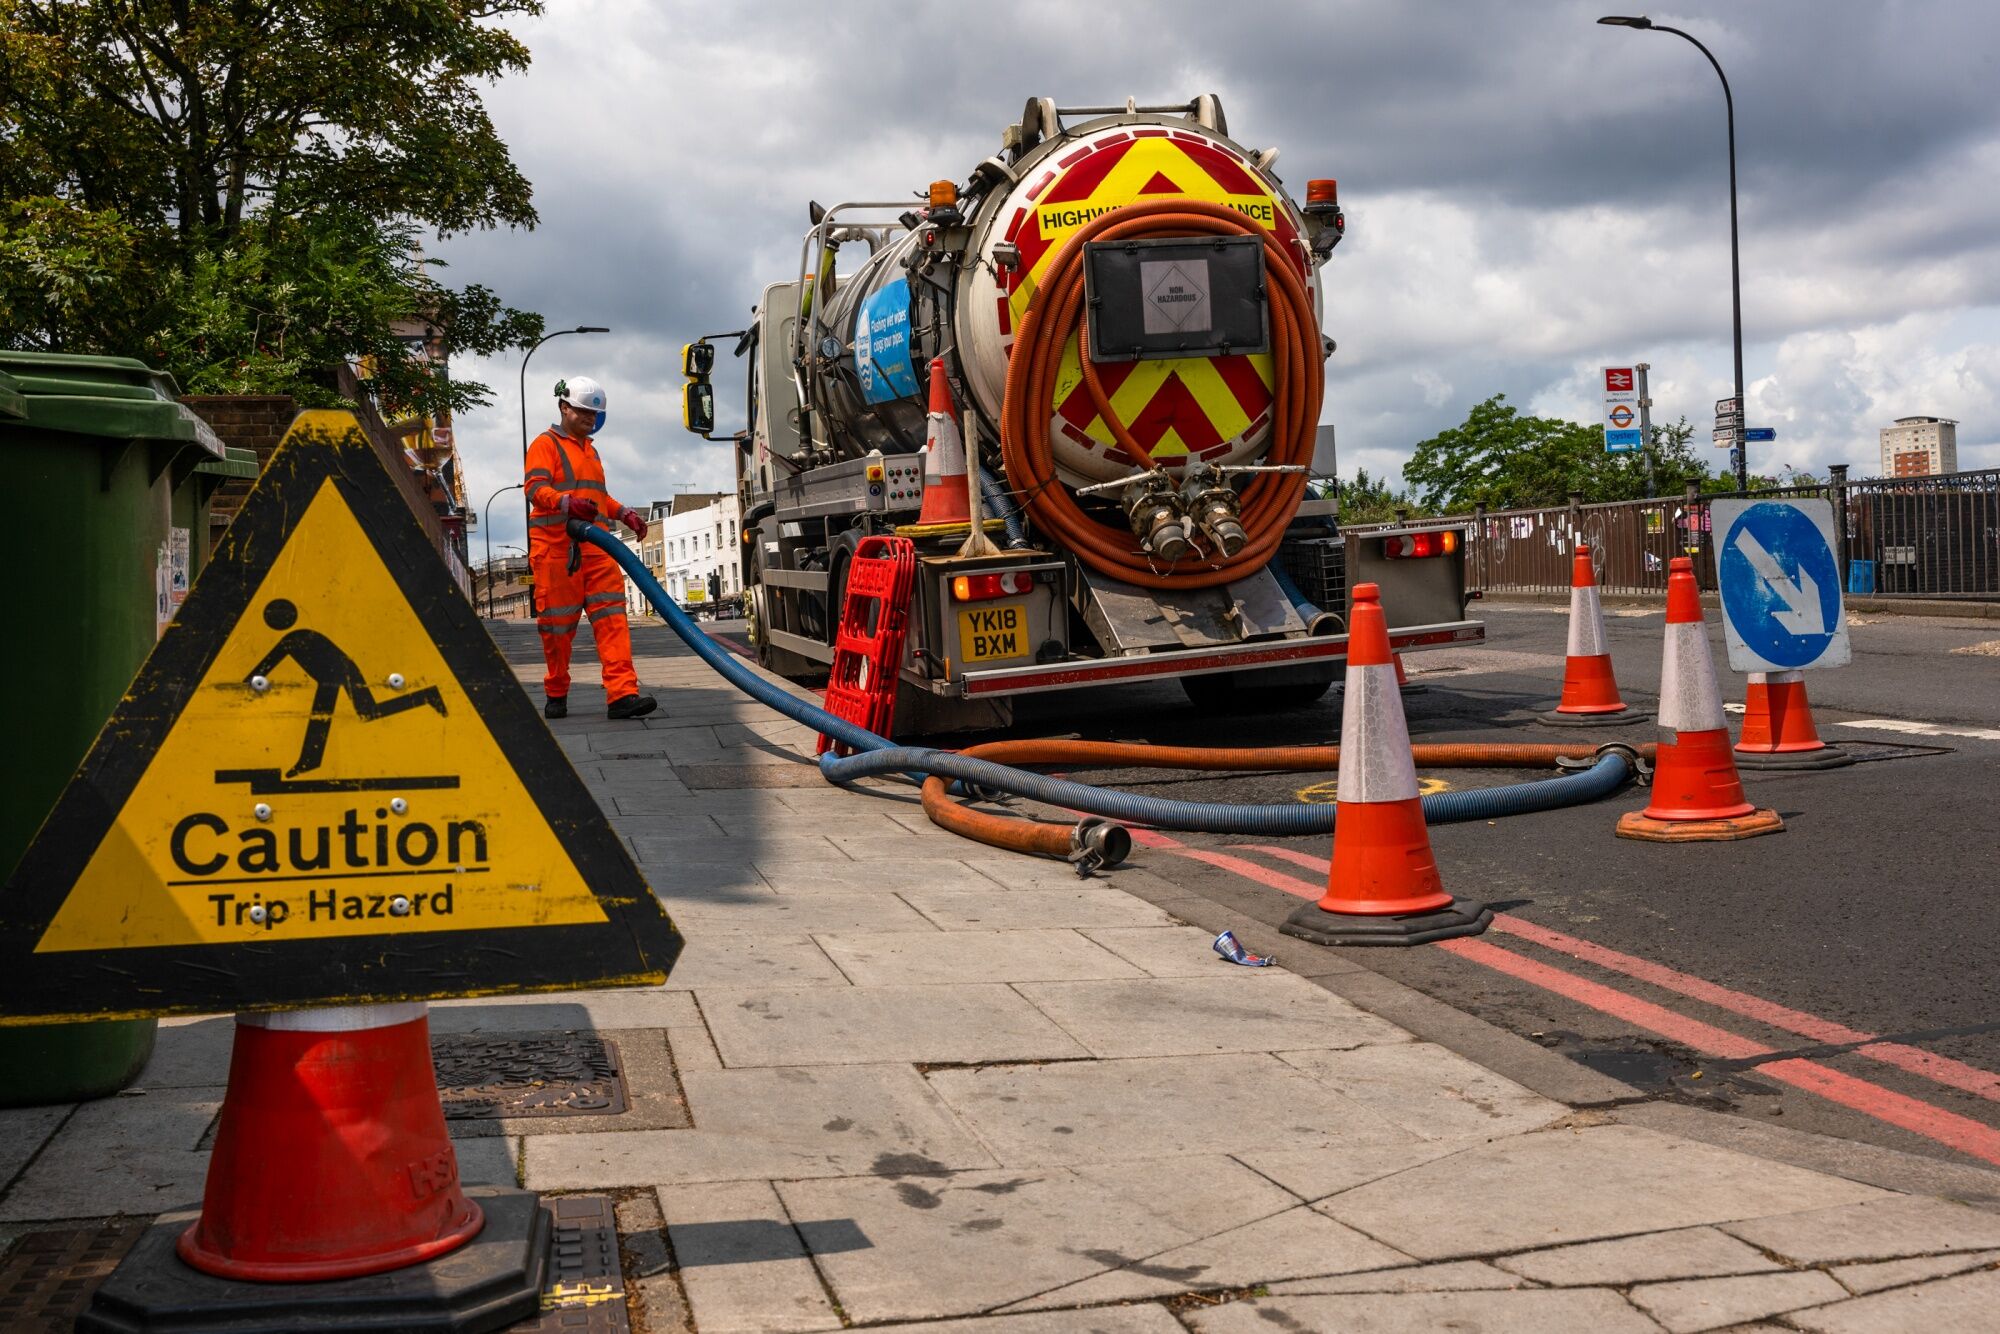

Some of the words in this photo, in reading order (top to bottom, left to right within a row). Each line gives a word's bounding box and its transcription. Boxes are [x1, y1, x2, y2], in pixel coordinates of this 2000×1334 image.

[1043, 205, 1122, 230] HIGHW
[1157, 294, 1197, 303] HAZARDOUS
[1169, 286, 1184, 294] NON
[968, 609, 1017, 632] YK18
[974, 633, 1017, 656] BXM
[170, 808, 487, 876] Caution
[309, 883, 453, 921] Hazard
